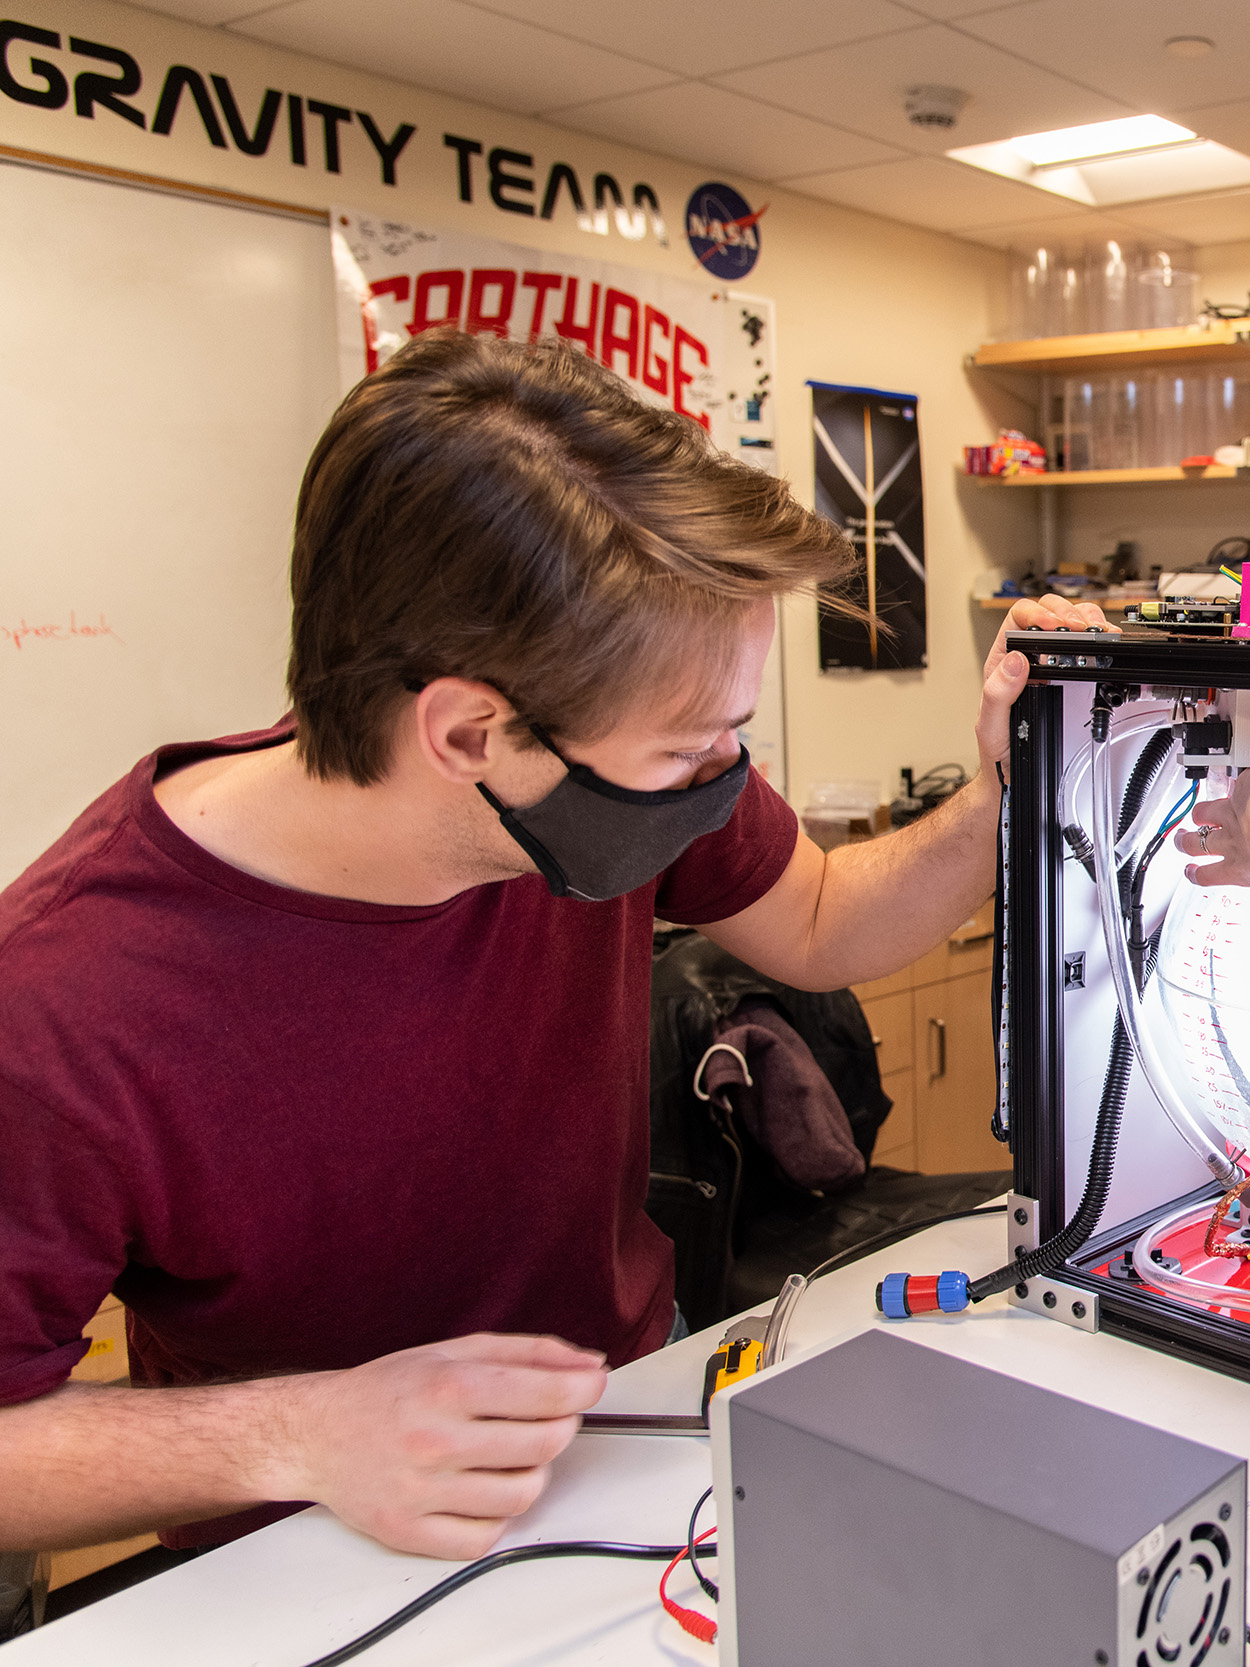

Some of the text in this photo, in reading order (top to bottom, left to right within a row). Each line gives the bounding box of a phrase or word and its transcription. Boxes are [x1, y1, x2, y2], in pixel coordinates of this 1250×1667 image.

[0, 19, 669, 247] GRAVITY TEAM
[688, 212, 758, 252] NASA
[360, 268, 712, 433] CARTHAGE
